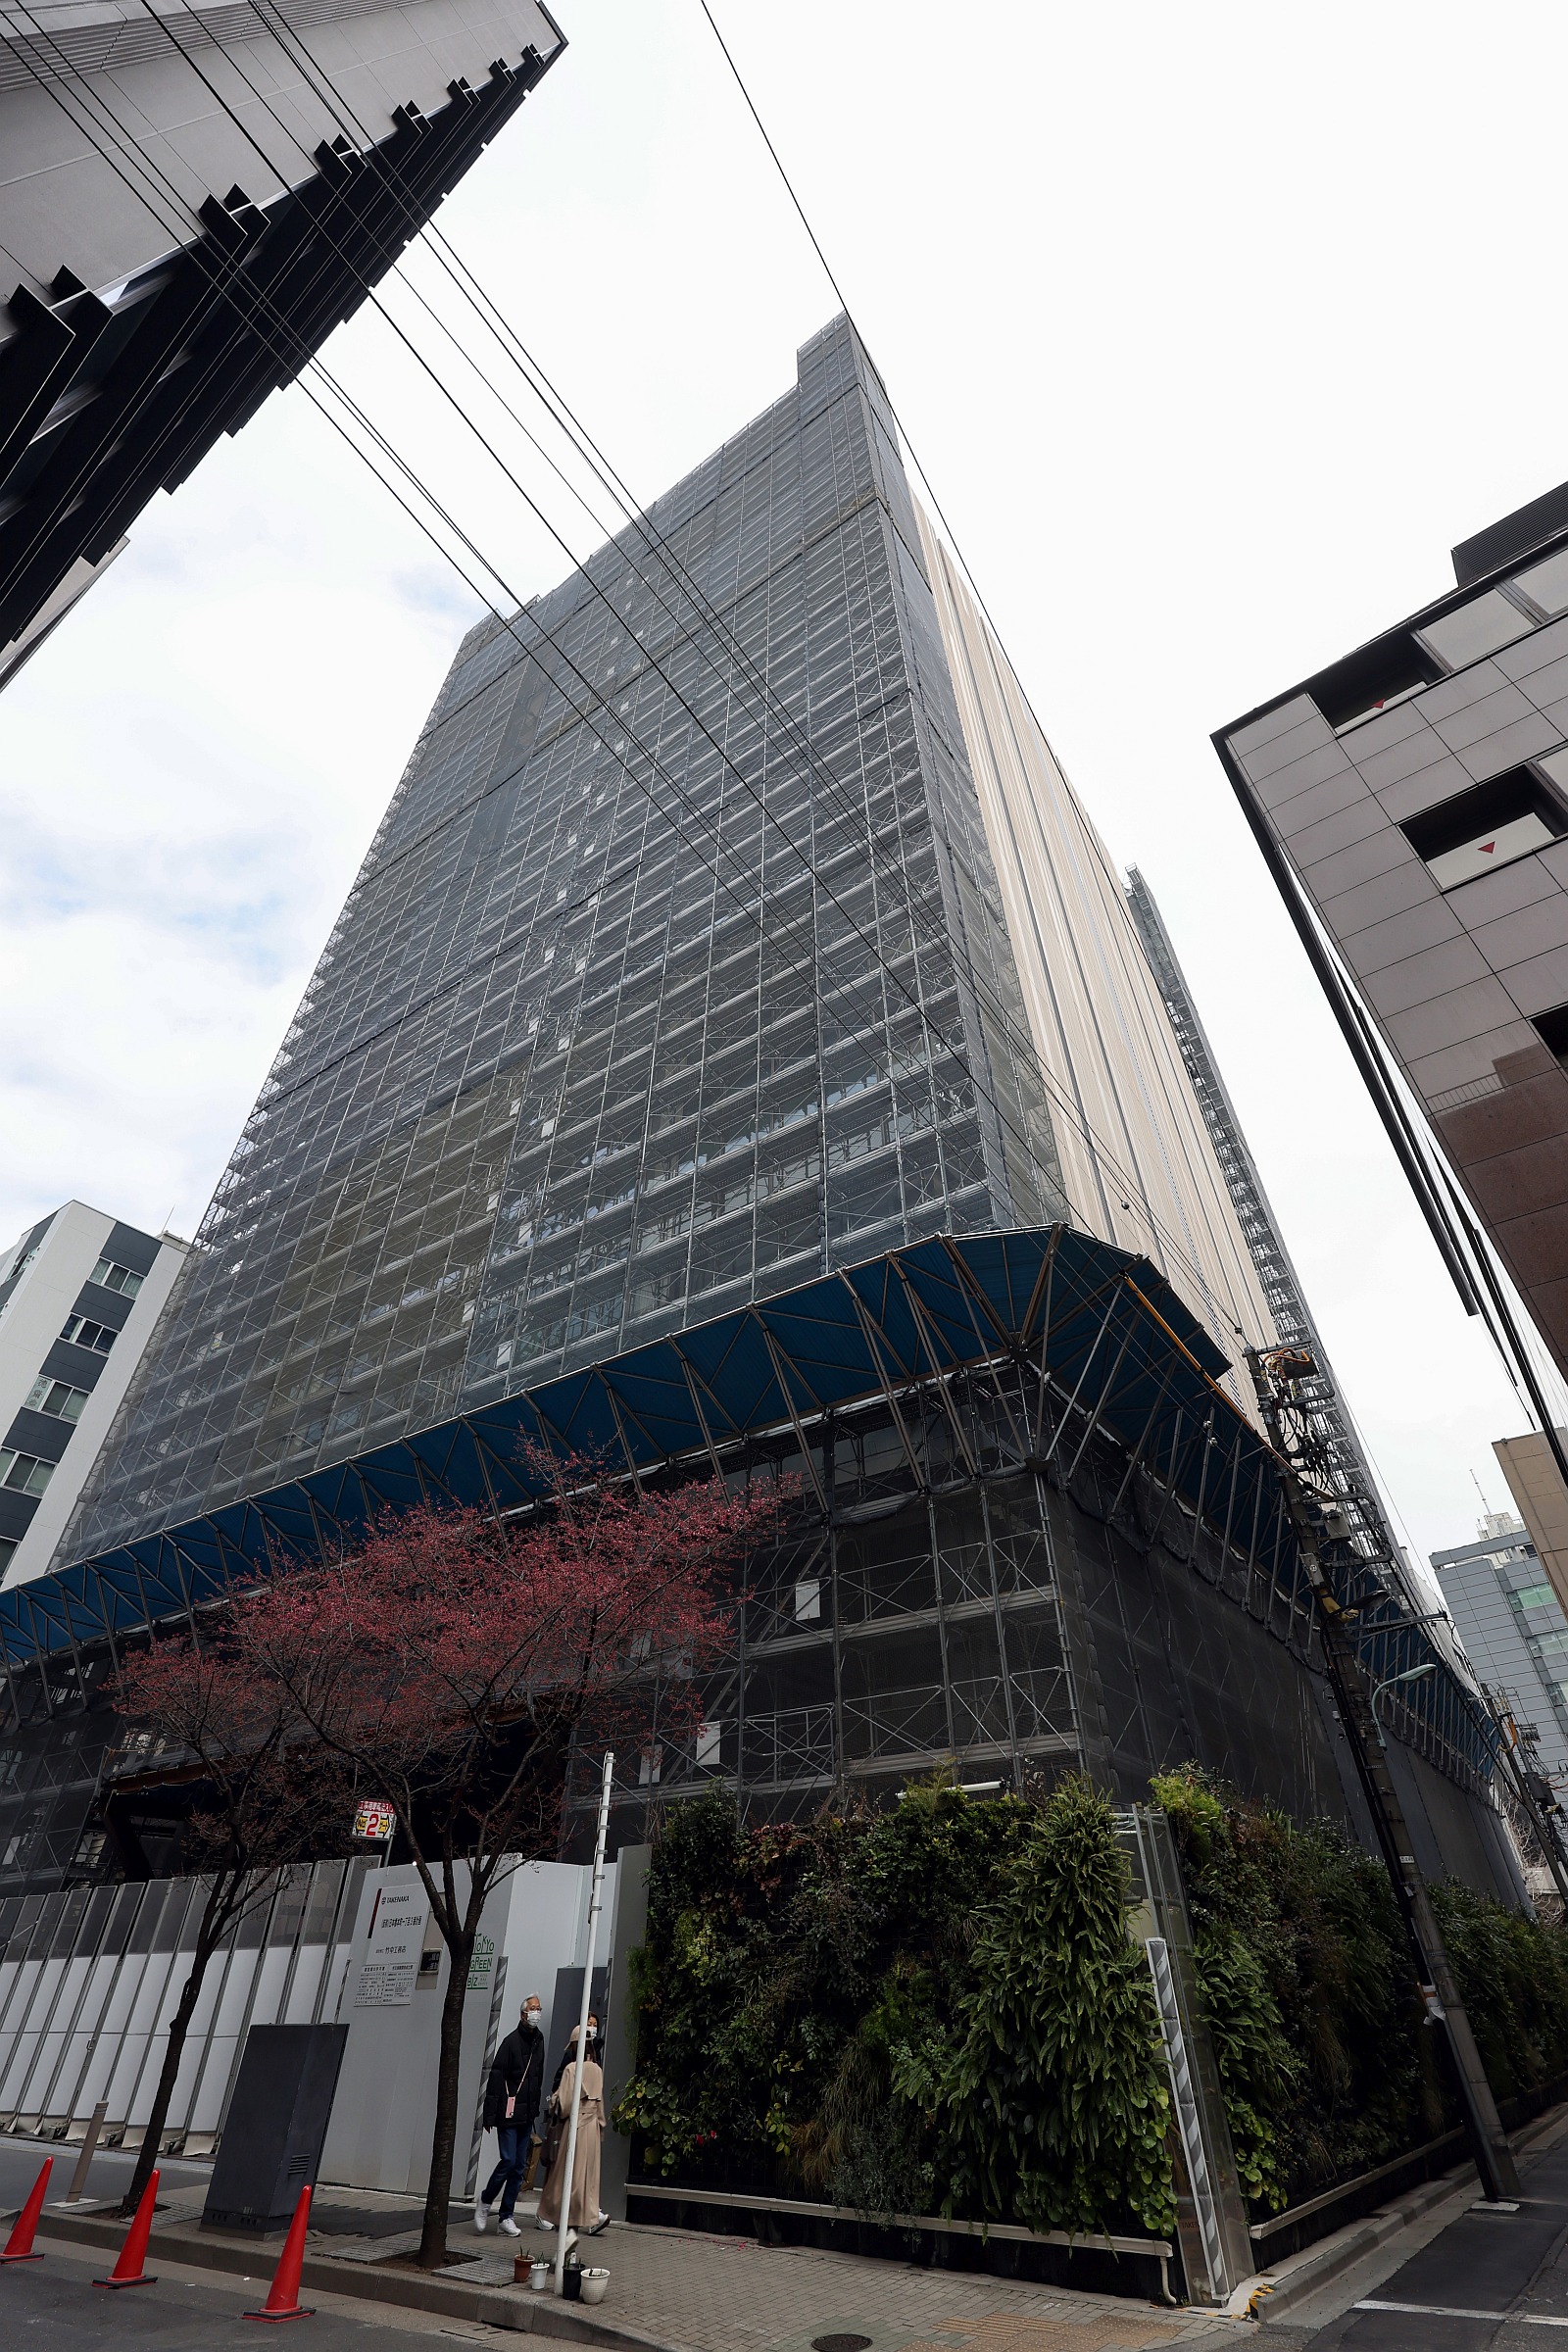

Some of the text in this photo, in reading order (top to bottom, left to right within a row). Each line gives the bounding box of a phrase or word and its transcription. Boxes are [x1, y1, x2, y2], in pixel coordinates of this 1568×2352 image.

[366, 1814, 379, 1836] 2
[474, 1934, 495, 1952] TOKYO
[470, 1957, 492, 1970] GREEN
[467, 1974, 478, 1987] BIZ
